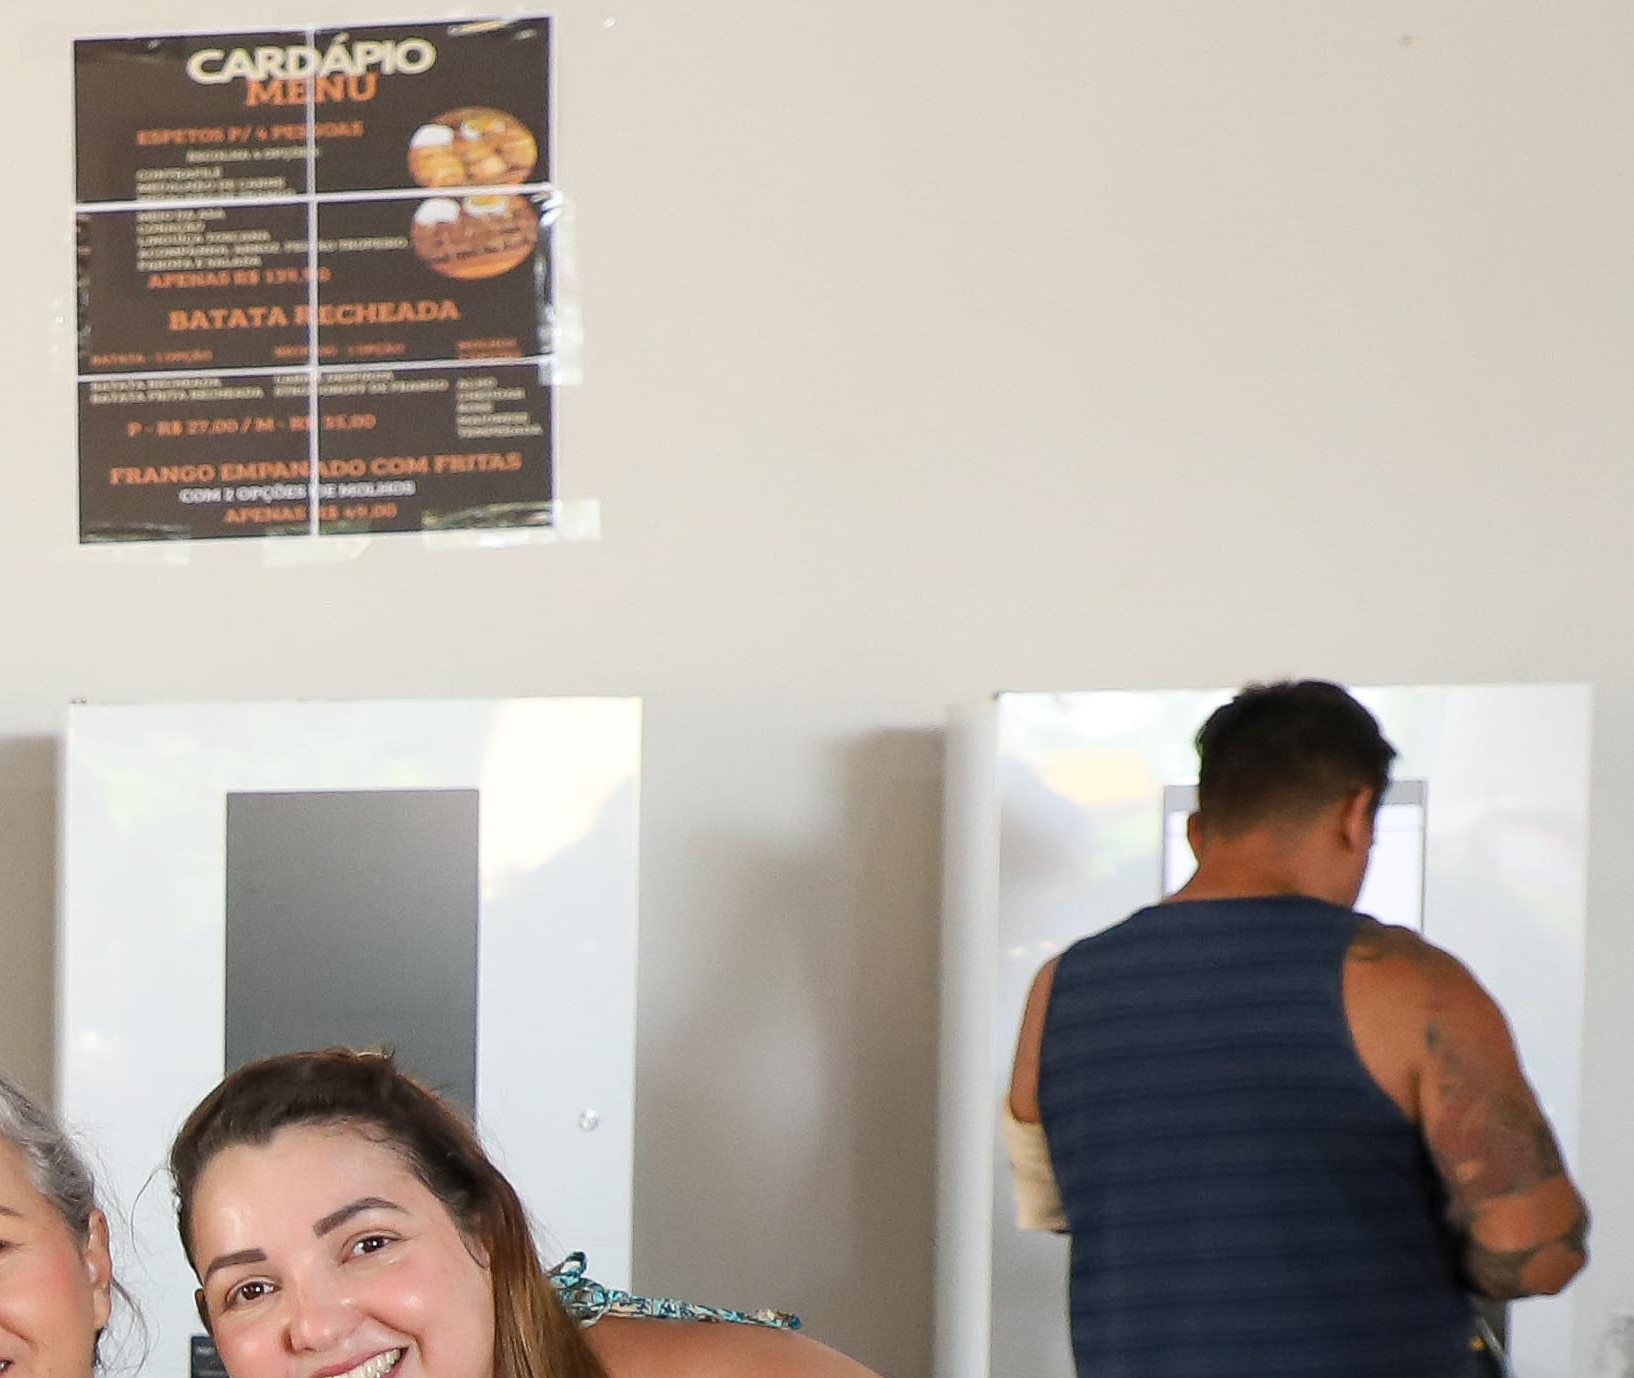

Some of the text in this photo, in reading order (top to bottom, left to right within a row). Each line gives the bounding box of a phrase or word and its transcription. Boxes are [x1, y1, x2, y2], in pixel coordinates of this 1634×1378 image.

[185, 34, 438, 84] CARDÁPIO
[244, 72, 379, 107] MENU
[147, 270, 231, 289] APENAS
[168, 299, 462, 332] BATATA RECHEADA
[126, 421, 142, 439] P
[109, 451, 523, 486] FRANGO EMPANADO COM FRITAS
[178, 486, 221, 504] COM
[235, 481, 307, 504] OPÇÕES
[338, 480, 416, 499] MOLHOS
[222, 505, 307, 524] APENAS
